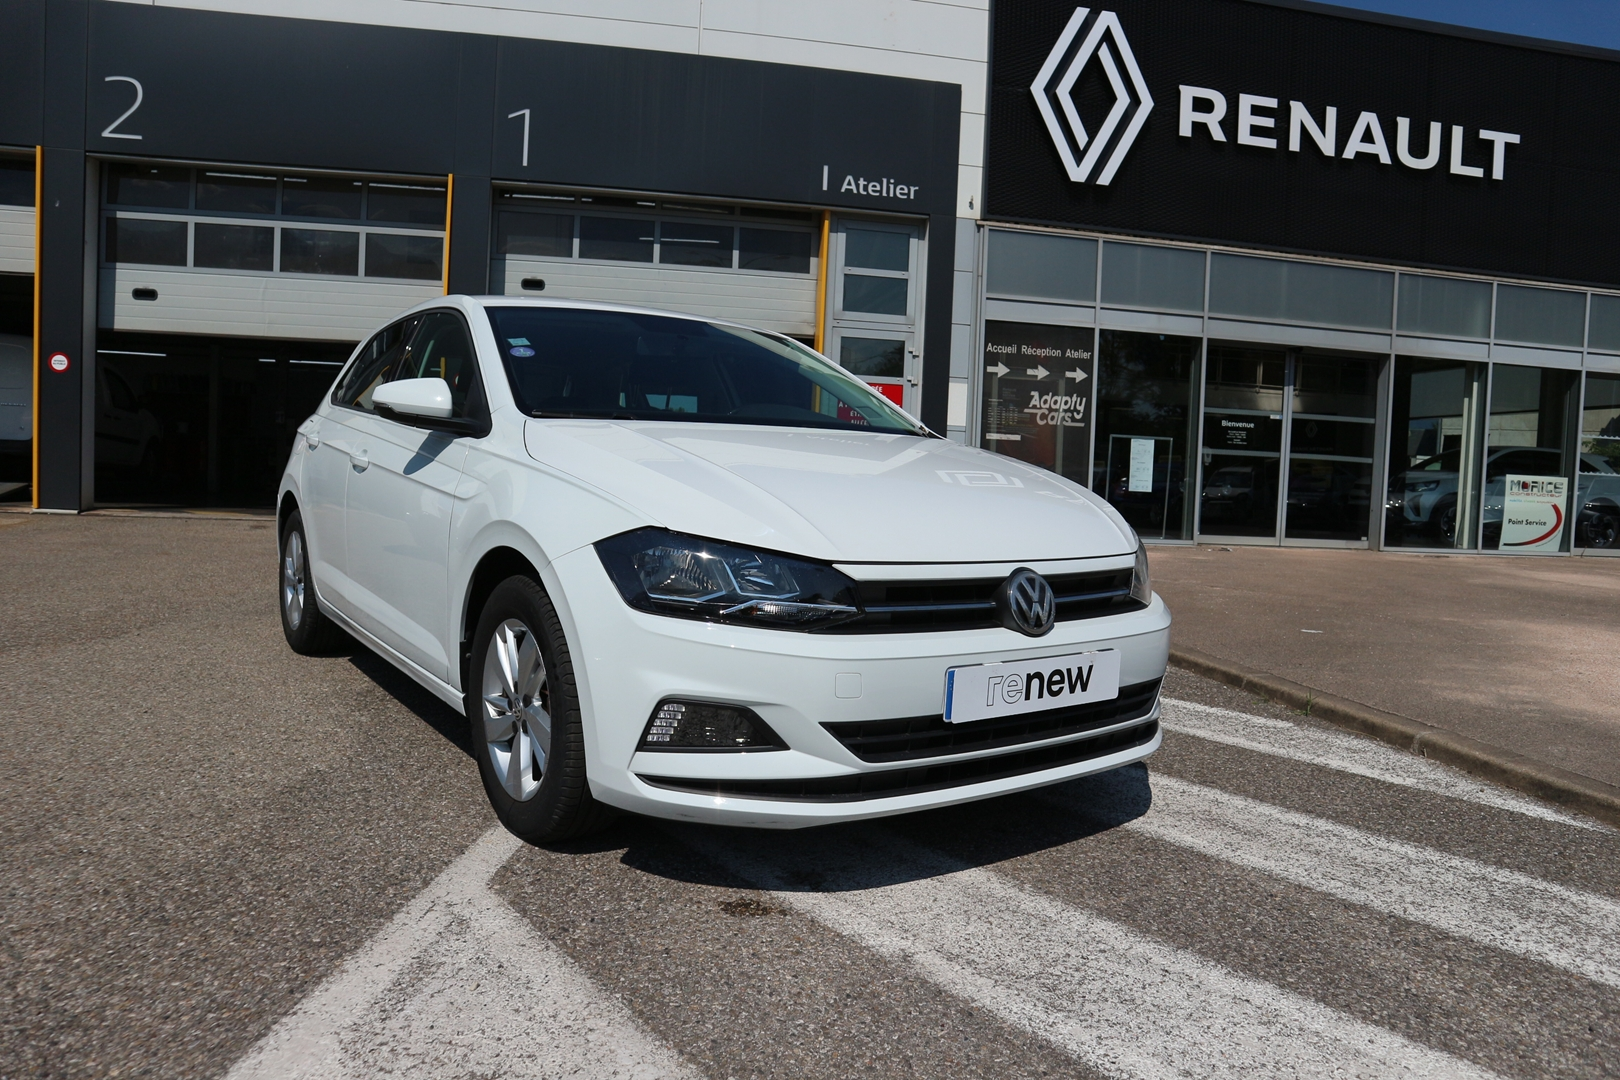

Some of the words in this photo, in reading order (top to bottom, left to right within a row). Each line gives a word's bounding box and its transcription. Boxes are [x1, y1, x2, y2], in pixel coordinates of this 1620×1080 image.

[101, 75, 143, 141] 2
[507, 108, 531, 167] 1
[1178, 84, 1521, 181] RENAULT
[840, 174, 919, 200] Atelier
[986, 342, 1017, 354] Accueil
[1021, 345, 1062, 358] Réception
[1065, 348, 1092, 360] Atelier
[1028, 391, 1087, 419] Adapty
[1032, 409, 1076, 426] Cars
[1221, 420, 1255, 429] Bienvenue
[1507, 518, 1524, 526] Point
[1524, 519, 1547, 527] Service
[986, 664, 1094, 707] renew
